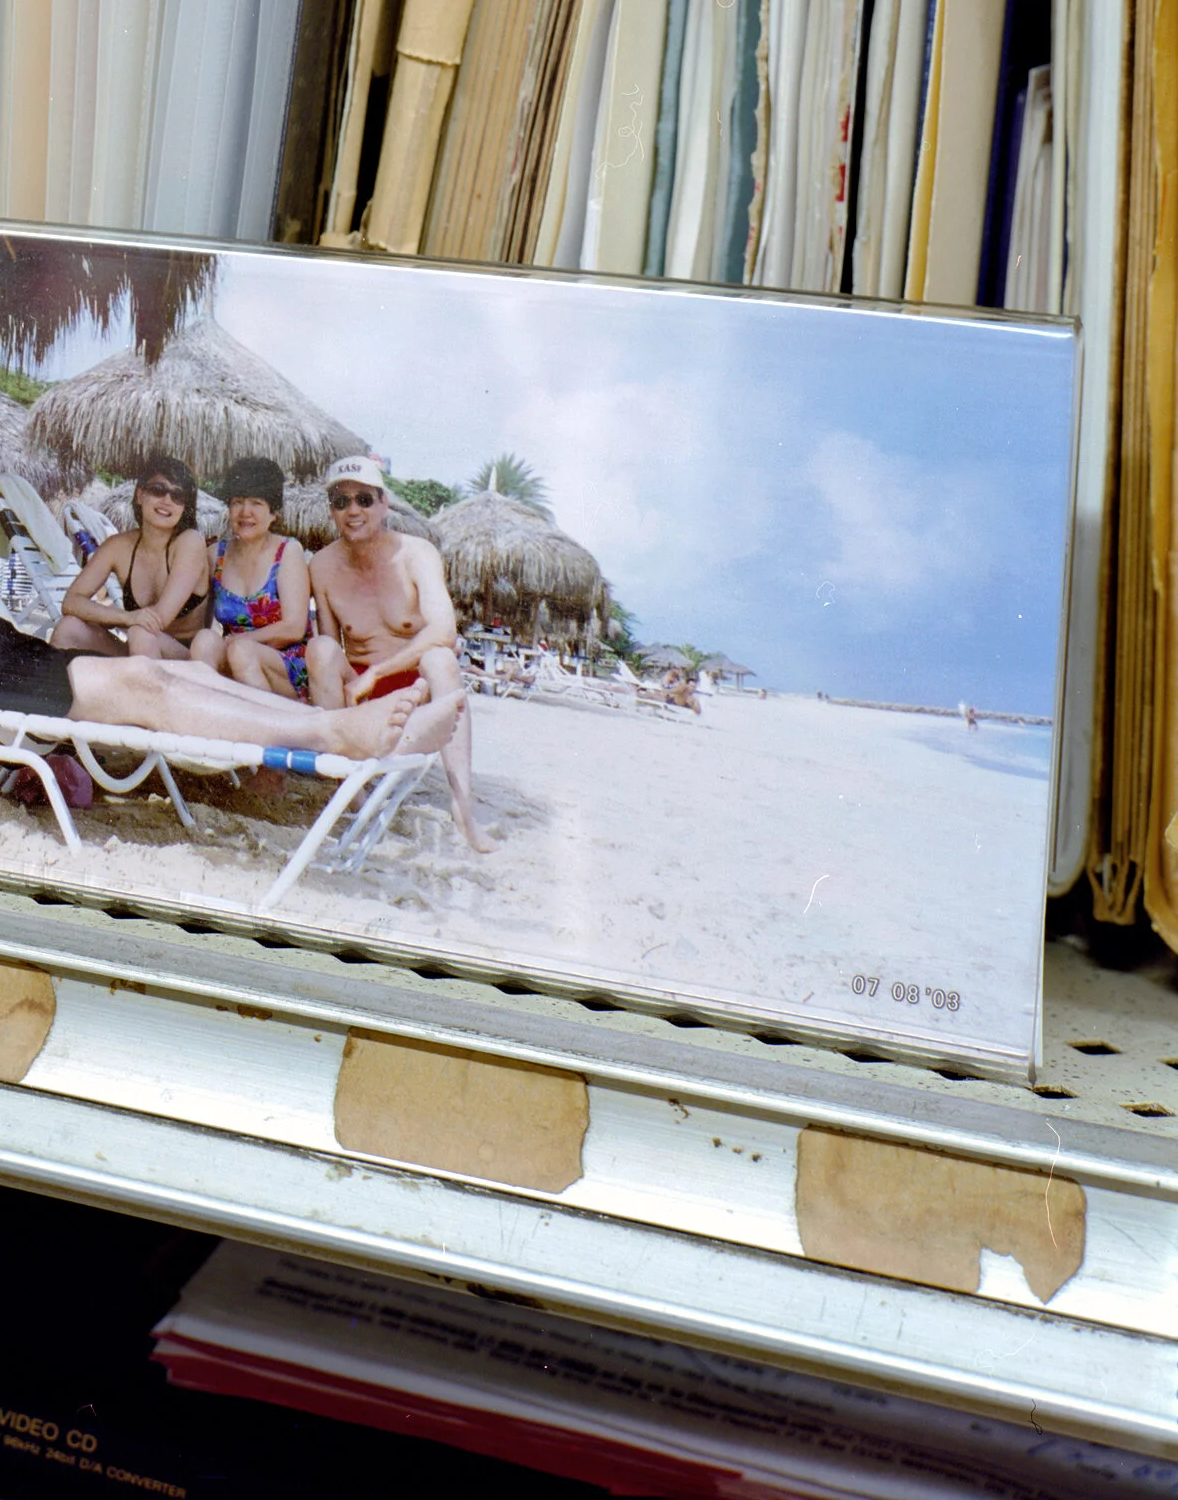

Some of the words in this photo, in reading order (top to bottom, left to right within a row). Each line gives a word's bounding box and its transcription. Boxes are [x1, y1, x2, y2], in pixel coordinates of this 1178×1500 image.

[852, 974, 880, 997] 07
[891, 982, 920, 1004] 08
[925, 986, 960, 1012] '03
[64, 1427, 99, 1454] CD
[106, 1464, 188, 1499] CONVERTER
